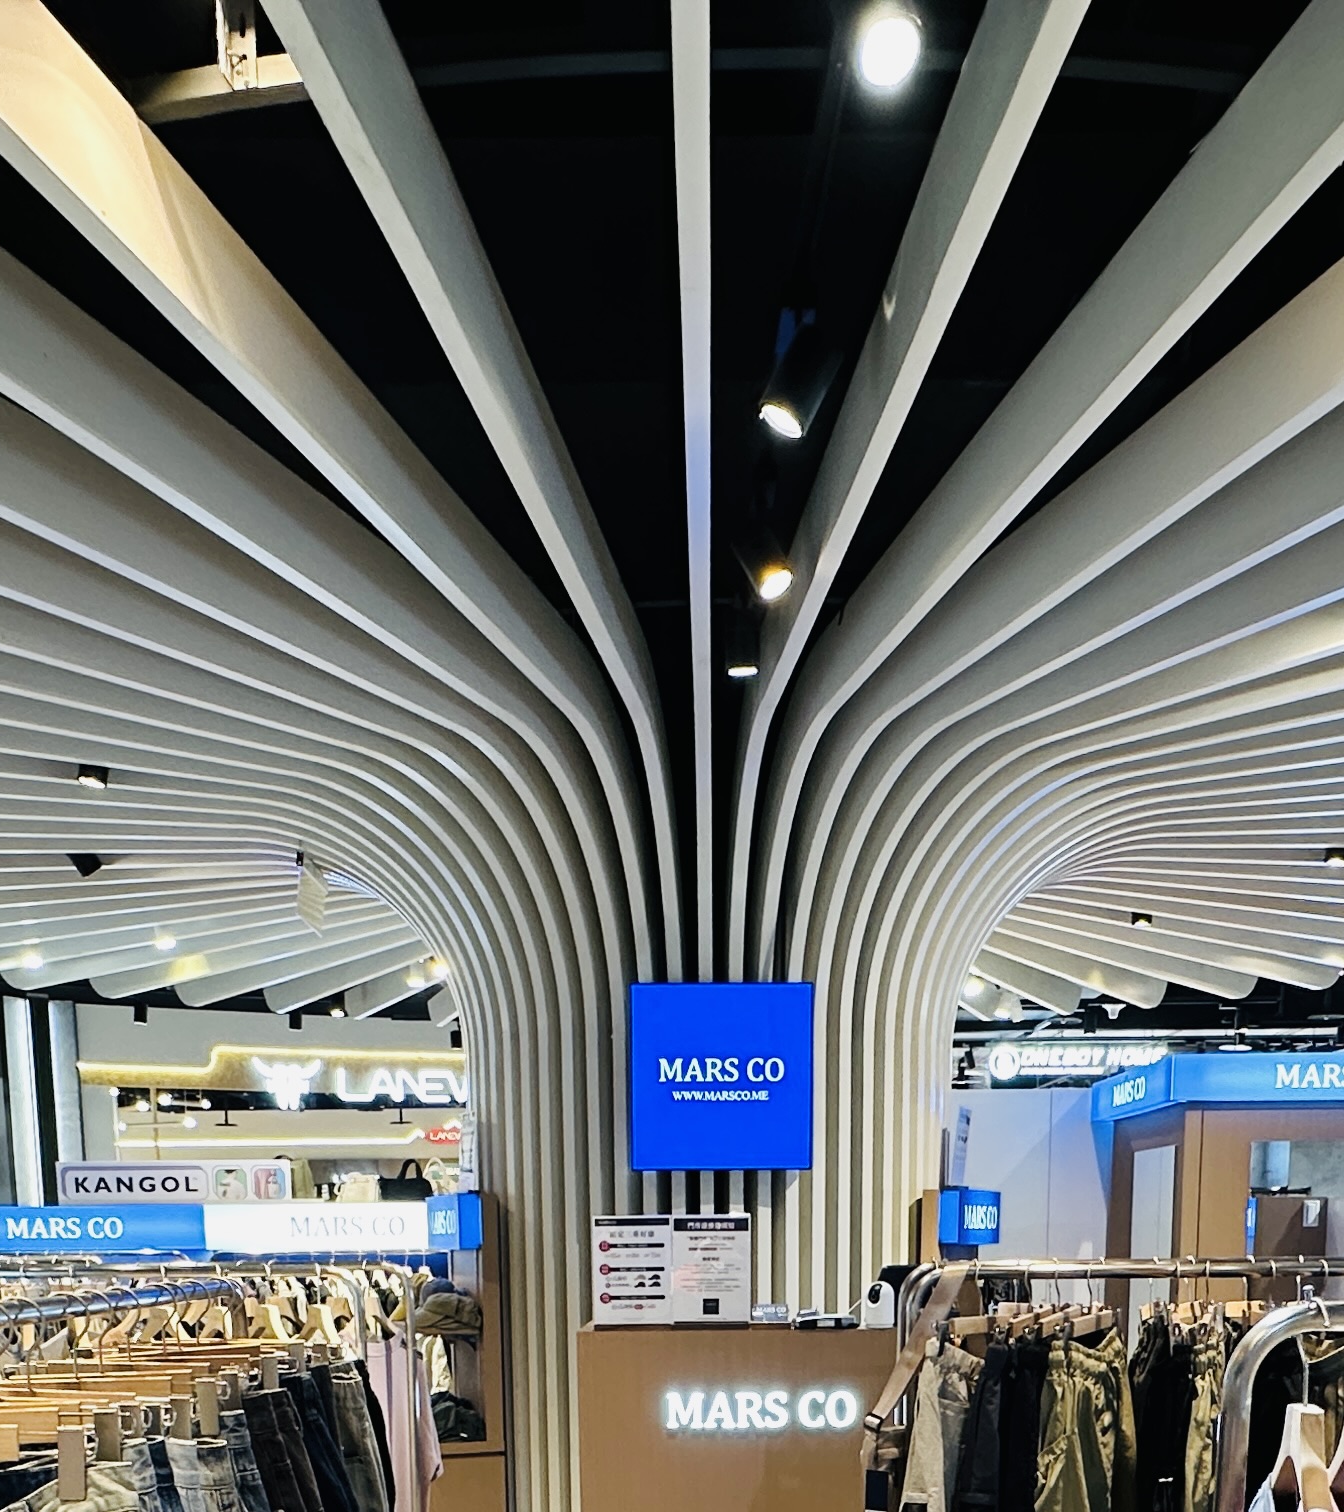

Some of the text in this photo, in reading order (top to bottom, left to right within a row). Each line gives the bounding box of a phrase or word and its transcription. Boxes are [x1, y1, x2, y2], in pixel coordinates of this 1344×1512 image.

[659, 1057, 785, 1083] MARS CO
[672, 1090, 770, 1102] WWW.MARSCO.ME
[1112, 1075, 1146, 1107] MARS CO
[74, 1175, 199, 1194] KANGOL
[6, 1216, 124, 1240] MARS CO
[290, 1216, 405, 1237] MARS CO
[963, 1204, 998, 1230] MARS CO
[665, 1390, 857, 1431] MARS CO
